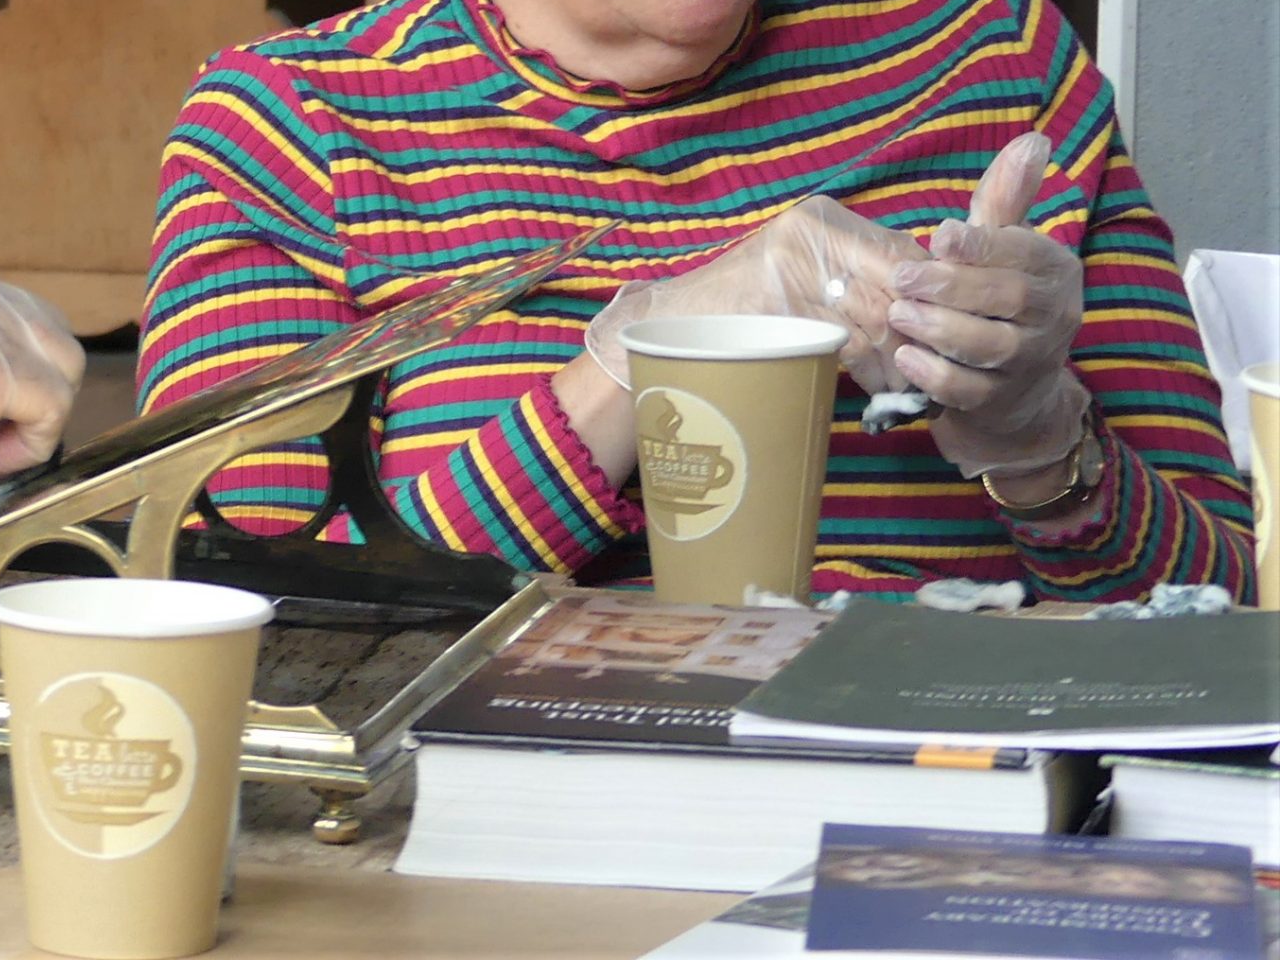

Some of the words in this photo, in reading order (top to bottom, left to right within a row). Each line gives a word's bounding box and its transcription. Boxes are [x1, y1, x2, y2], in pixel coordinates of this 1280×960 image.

[643, 439, 679, 460] TEA
[657, 461, 709, 477] COFFEE
[543, 710, 646, 725] Trust
[52, 739, 113, 761] TEA
[77, 762, 154, 779] COFFEE
[944, 895, 1211, 921] CONSERVATION
[922, 911, 1211, 938] CONTEMPORARY
